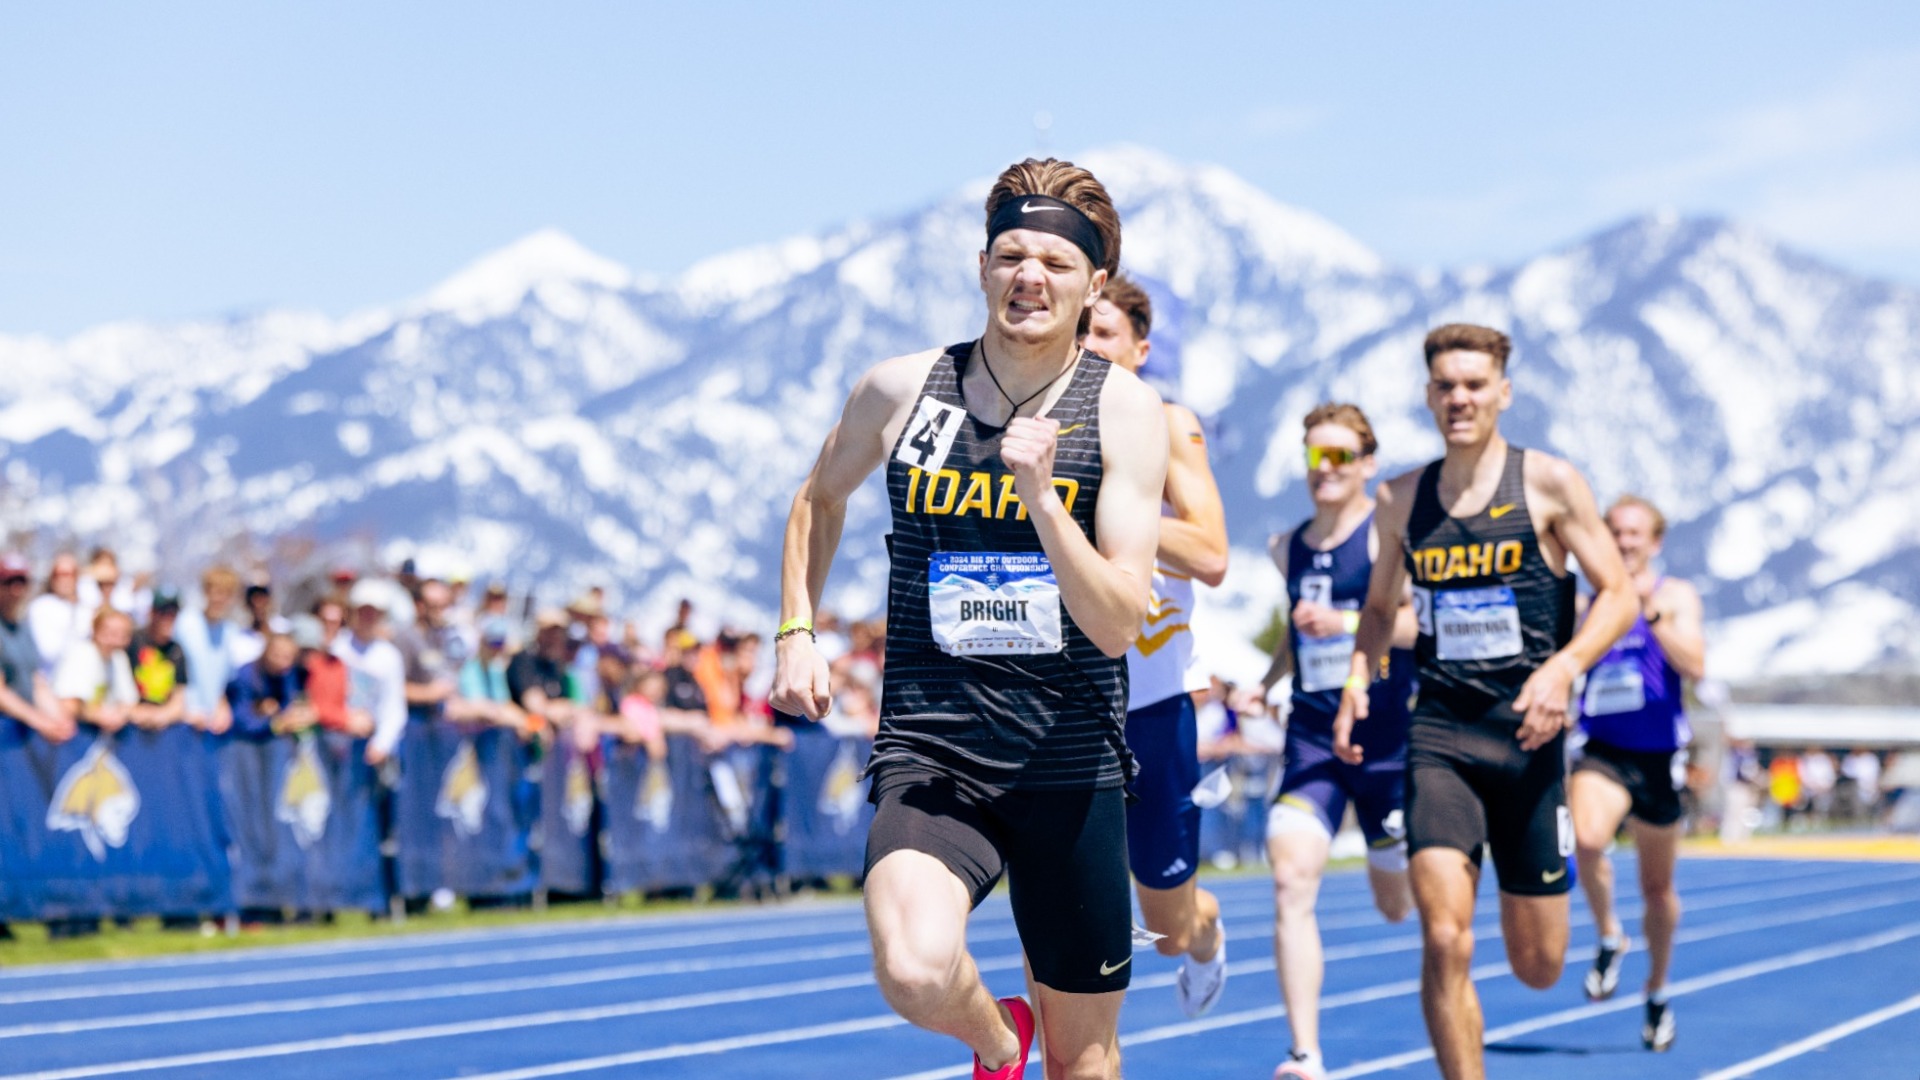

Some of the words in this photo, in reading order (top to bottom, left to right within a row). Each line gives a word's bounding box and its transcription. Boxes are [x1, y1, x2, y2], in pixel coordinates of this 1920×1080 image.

[910, 408, 952, 466] 4
[938, 563, 989, 573] CONFERENCE
[970, 555, 984, 565] BIG
[985, 555, 1000, 565] SKY
[1001, 555, 1038, 565] OUTDOOR
[1411, 540, 1523, 582] IDAHO
[960, 599, 1029, 622] BRIGHT
